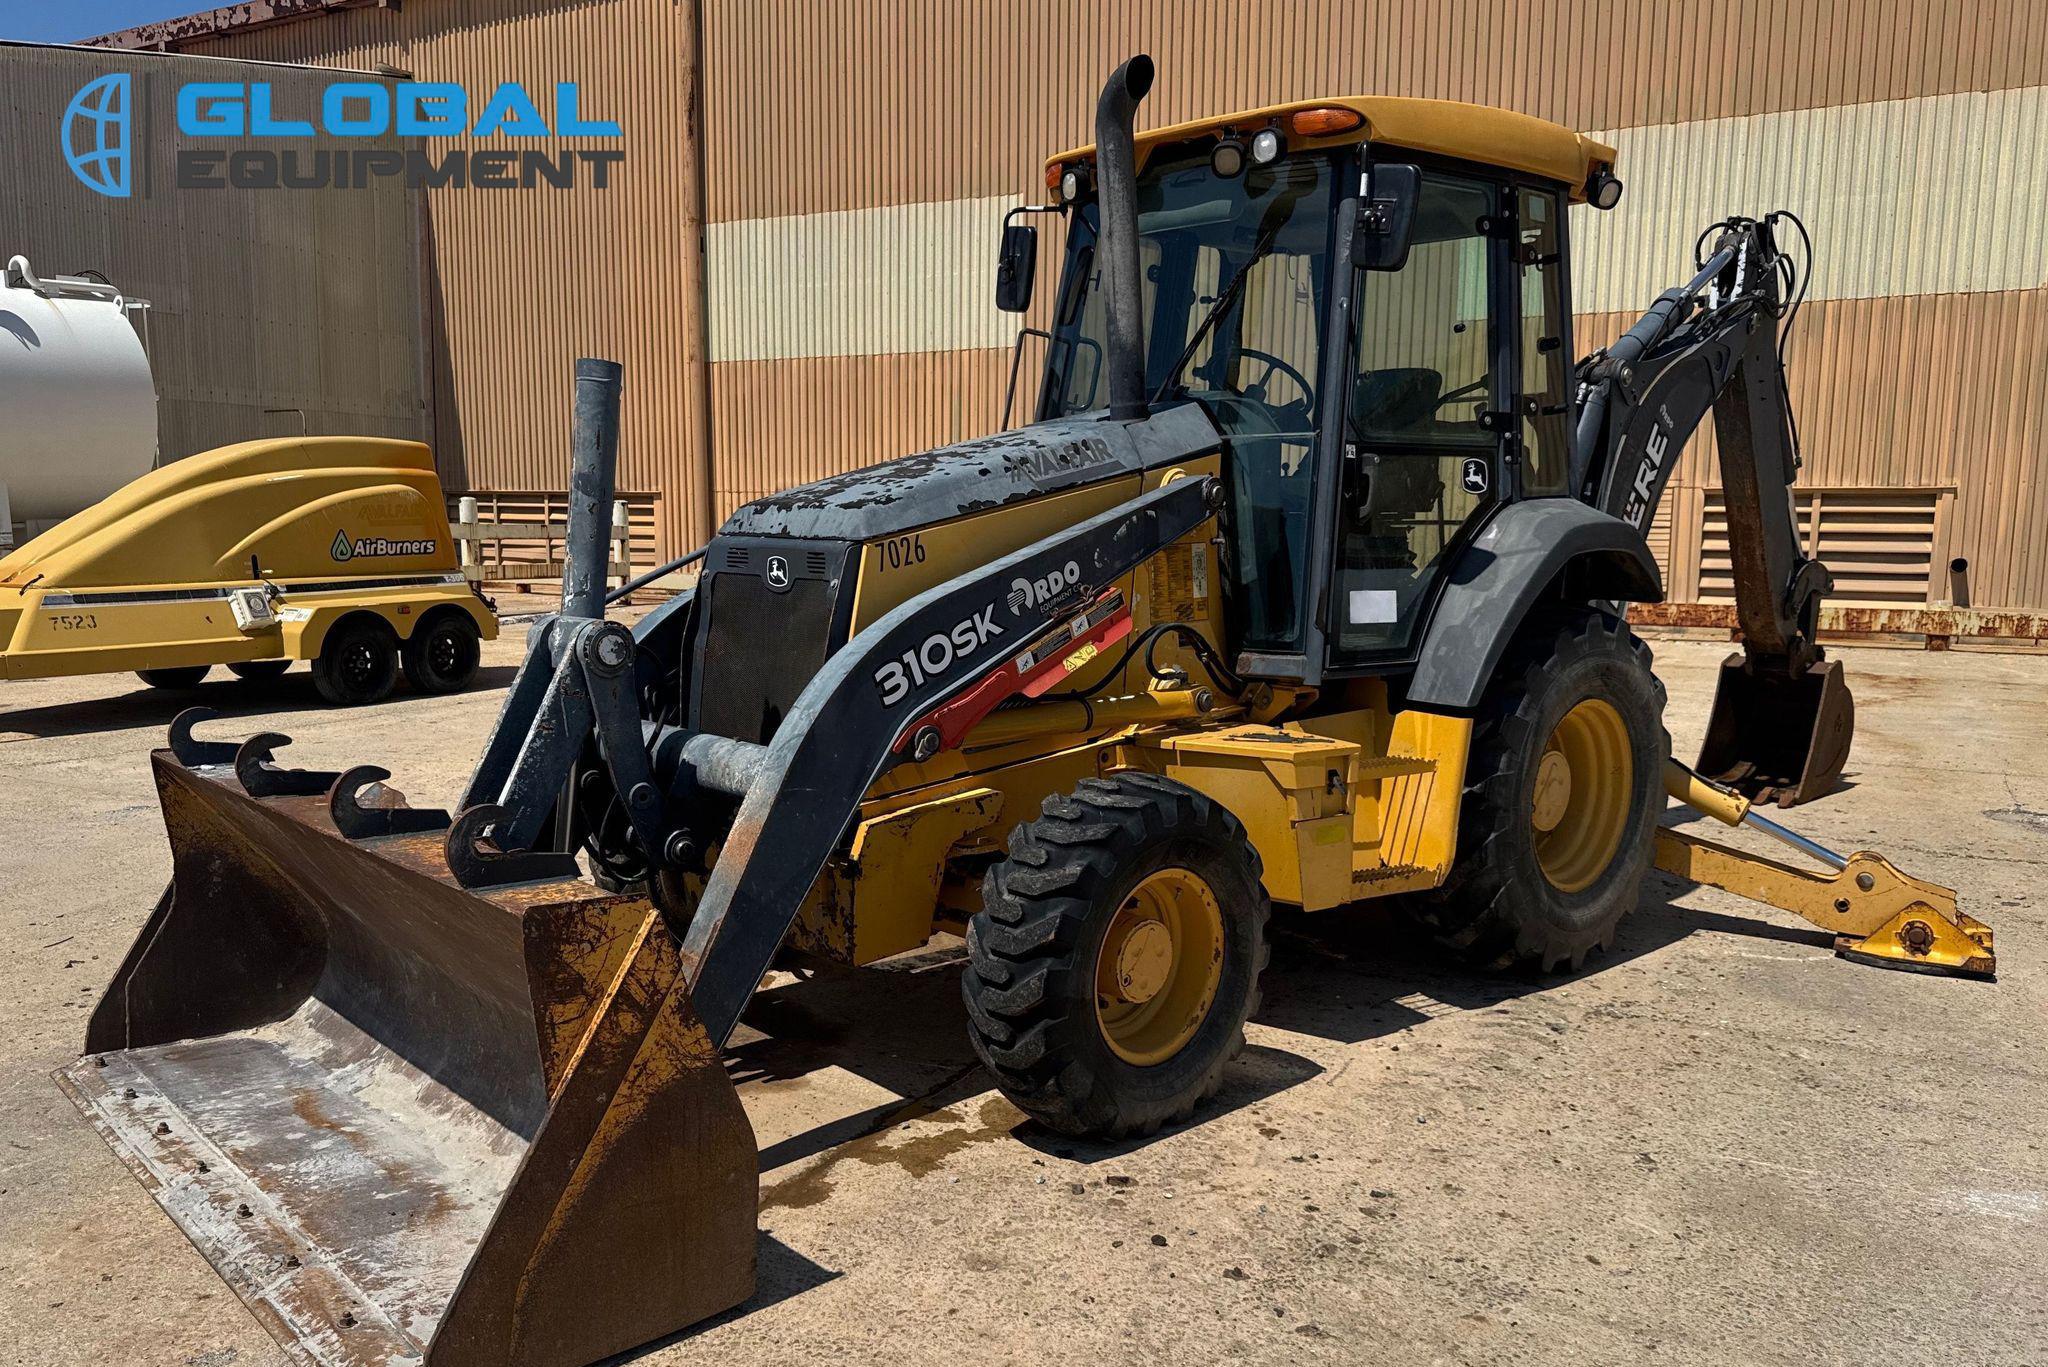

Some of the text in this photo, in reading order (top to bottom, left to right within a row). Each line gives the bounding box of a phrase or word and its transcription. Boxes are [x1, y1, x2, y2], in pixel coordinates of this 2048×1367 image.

[353, 538, 436, 557] AirBurners
[874, 534, 926, 572] 7026
[48, 614, 97, 632] 7523
[874, 602, 1005, 706] 310SK
